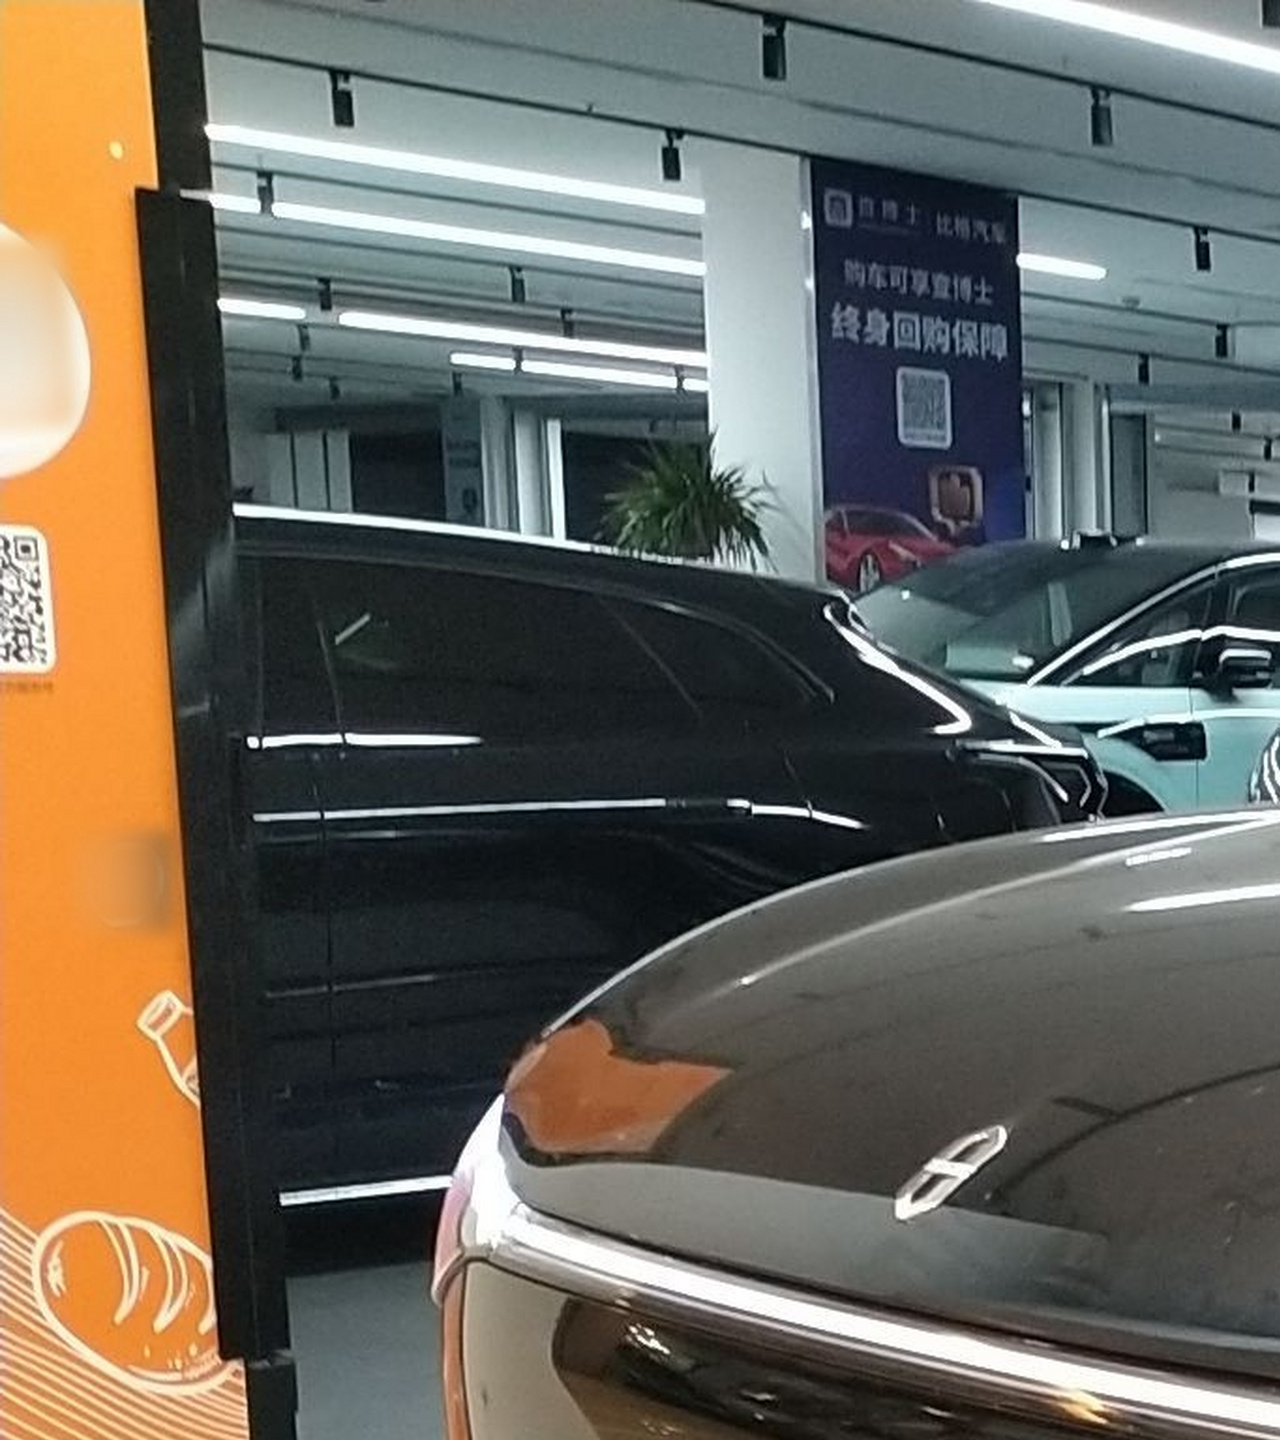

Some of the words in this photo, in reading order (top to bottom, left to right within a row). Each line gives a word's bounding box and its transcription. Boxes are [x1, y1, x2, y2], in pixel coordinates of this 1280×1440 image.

[831, 301, 1008, 362] 终身回购保障
